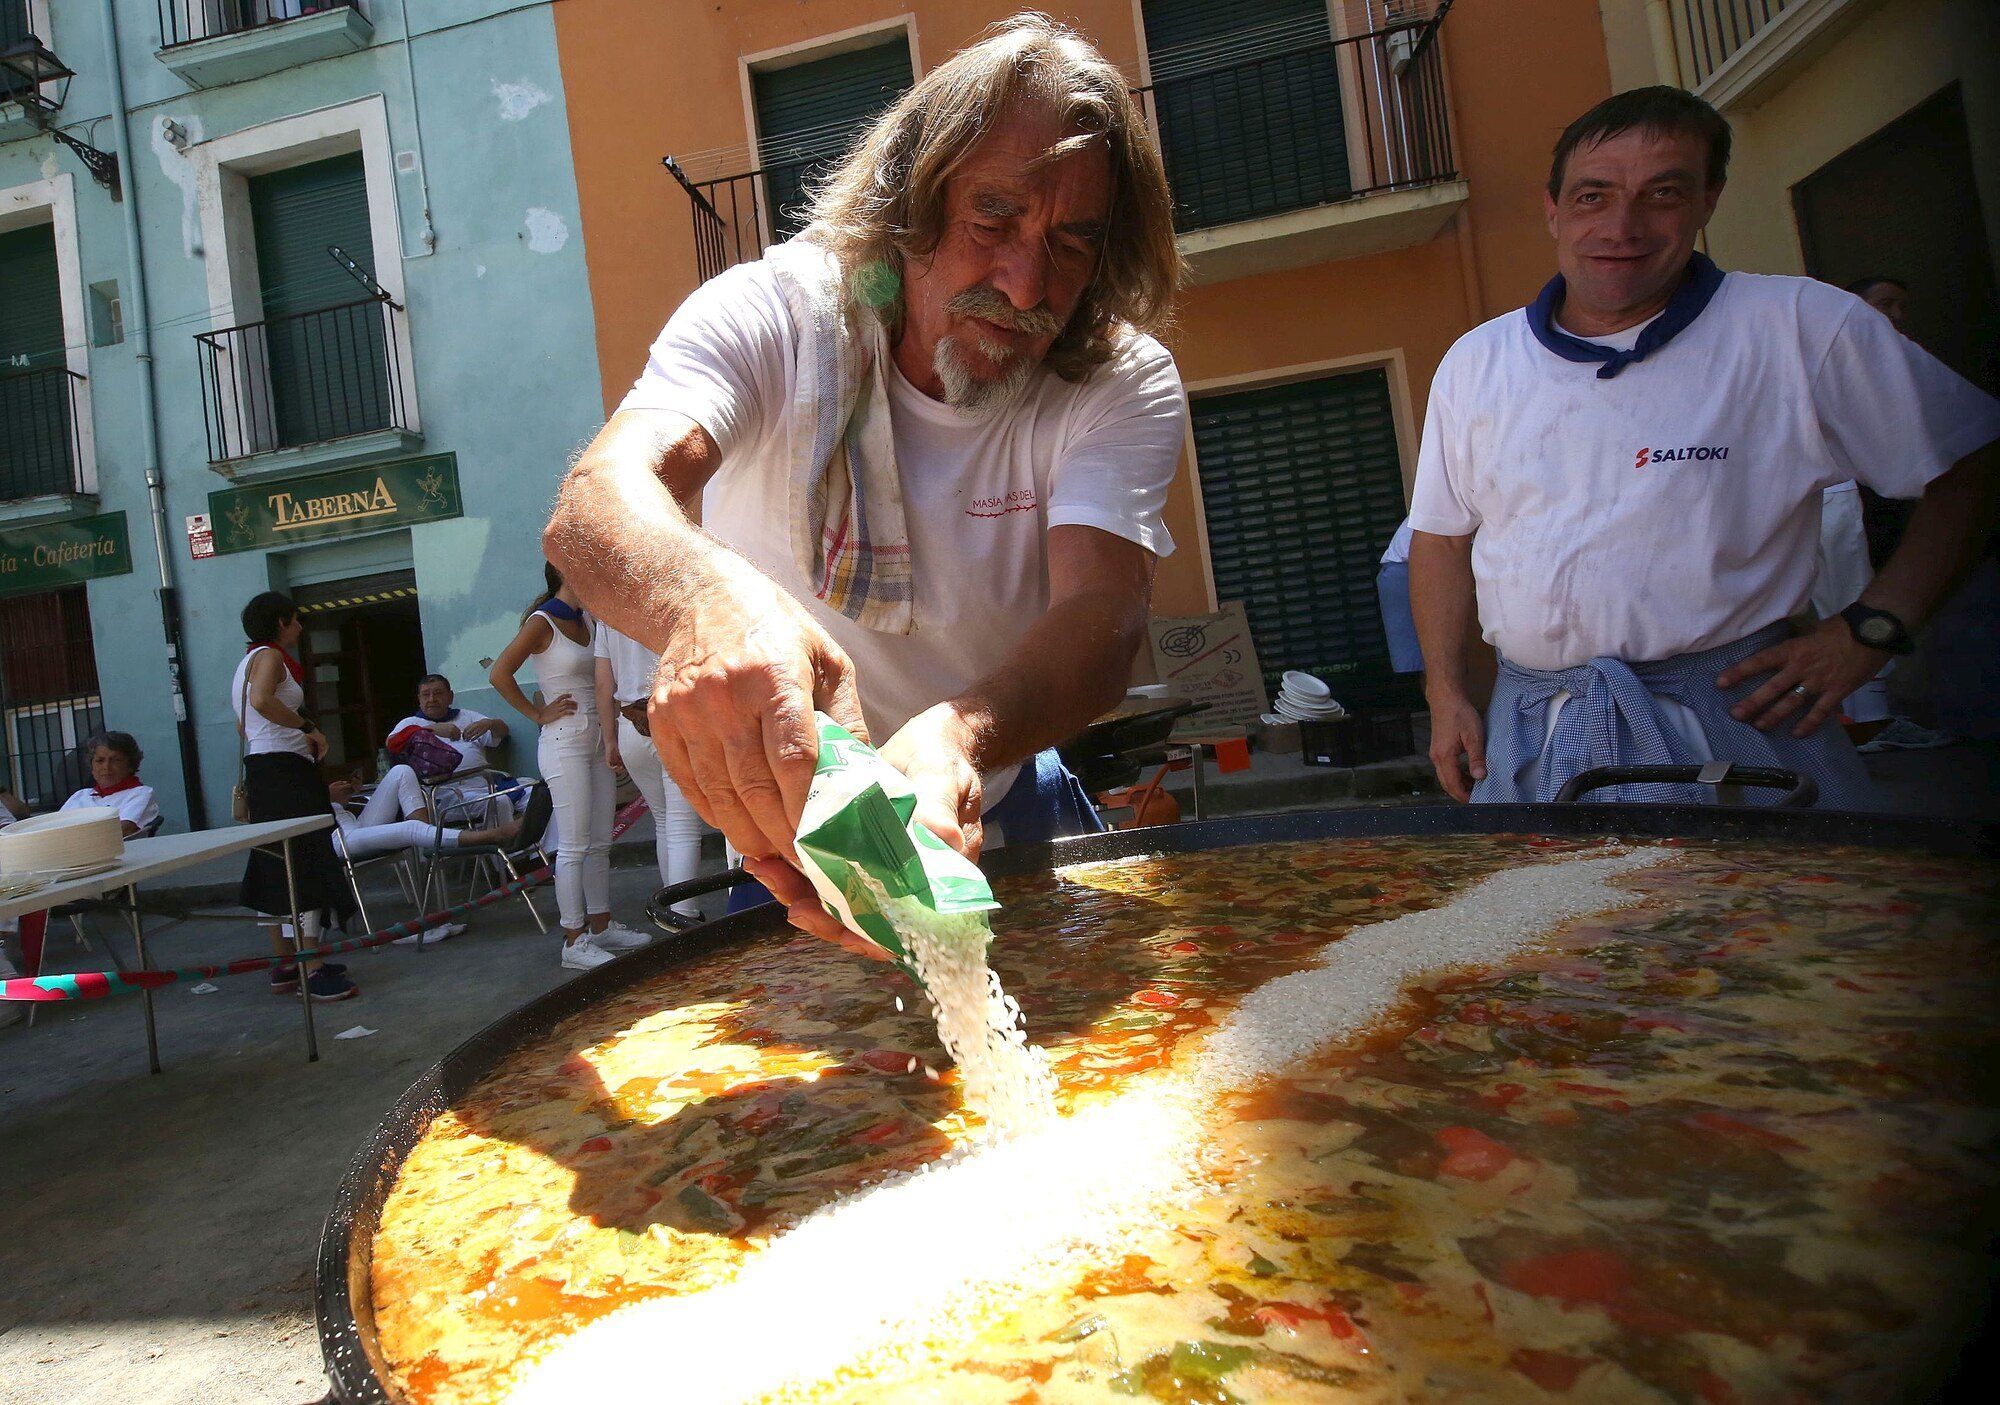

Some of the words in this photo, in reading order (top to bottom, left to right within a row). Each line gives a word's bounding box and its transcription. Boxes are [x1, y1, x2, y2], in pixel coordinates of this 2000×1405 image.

[1651, 447, 1729, 463] SALTOKI
[269, 476, 397, 525] TABERNA
[1021, 489, 1035, 501] DEL
[33, 535, 116, 567] Cafetería
